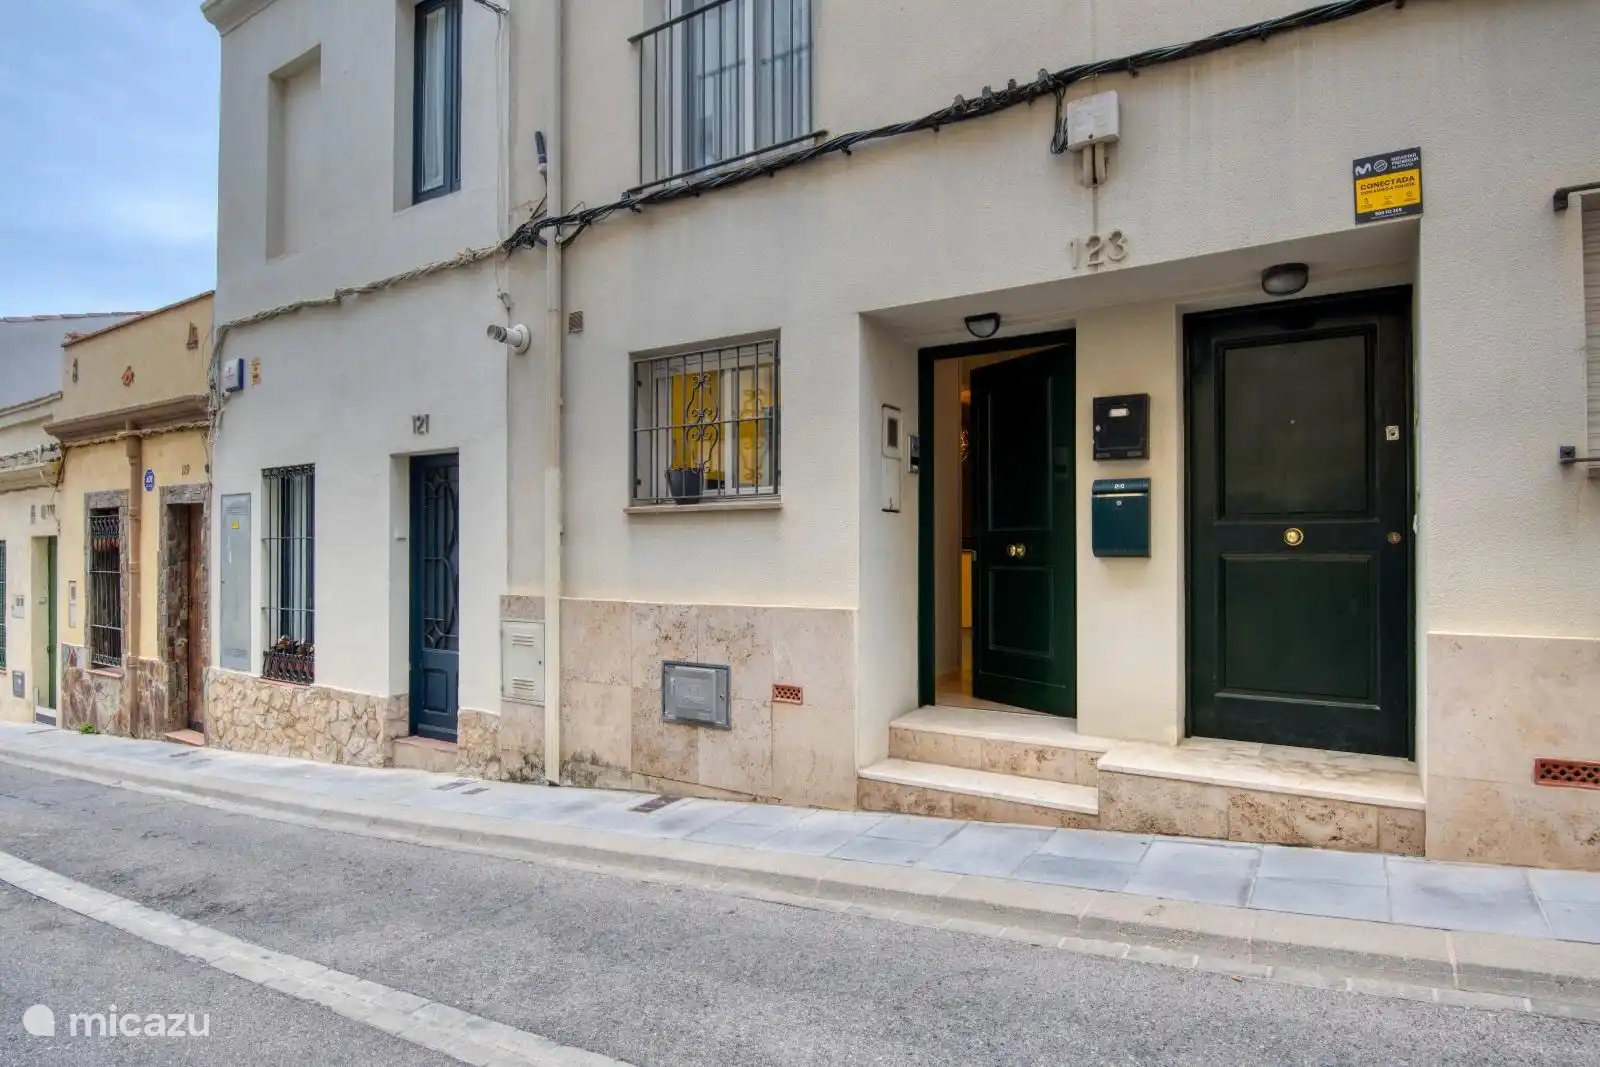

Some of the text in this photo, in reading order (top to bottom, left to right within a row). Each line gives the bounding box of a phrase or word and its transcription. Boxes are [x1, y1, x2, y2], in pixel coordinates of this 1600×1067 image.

[1360, 176, 1415, 190] CONECTADA
[1070, 229, 1129, 269] 123
[412, 413, 430, 435] 121
